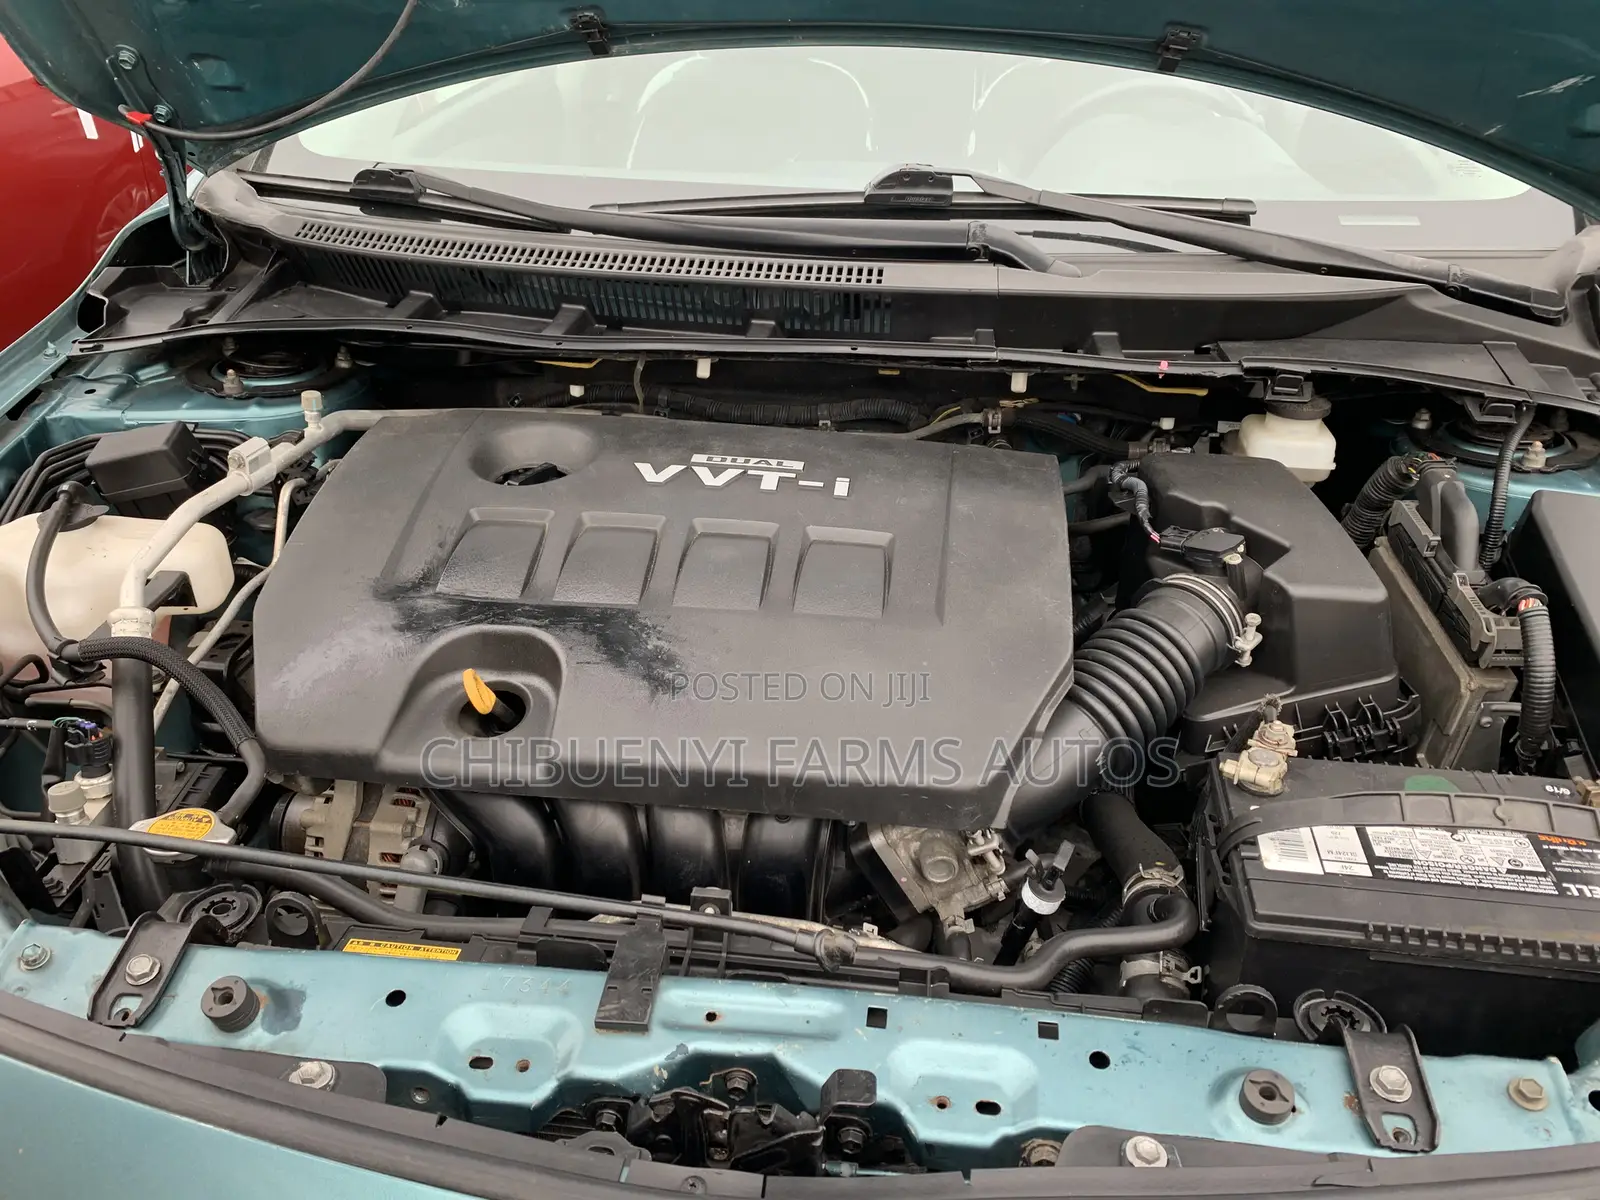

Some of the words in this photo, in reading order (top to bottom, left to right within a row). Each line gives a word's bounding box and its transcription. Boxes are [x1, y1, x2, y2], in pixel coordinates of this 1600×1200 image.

[706, 455, 794, 468] DUAL
[633, 462, 851, 498] VVT-i
[380, 943, 414, 951] CAUTION
[419, 946, 459, 955] ATTENTION
